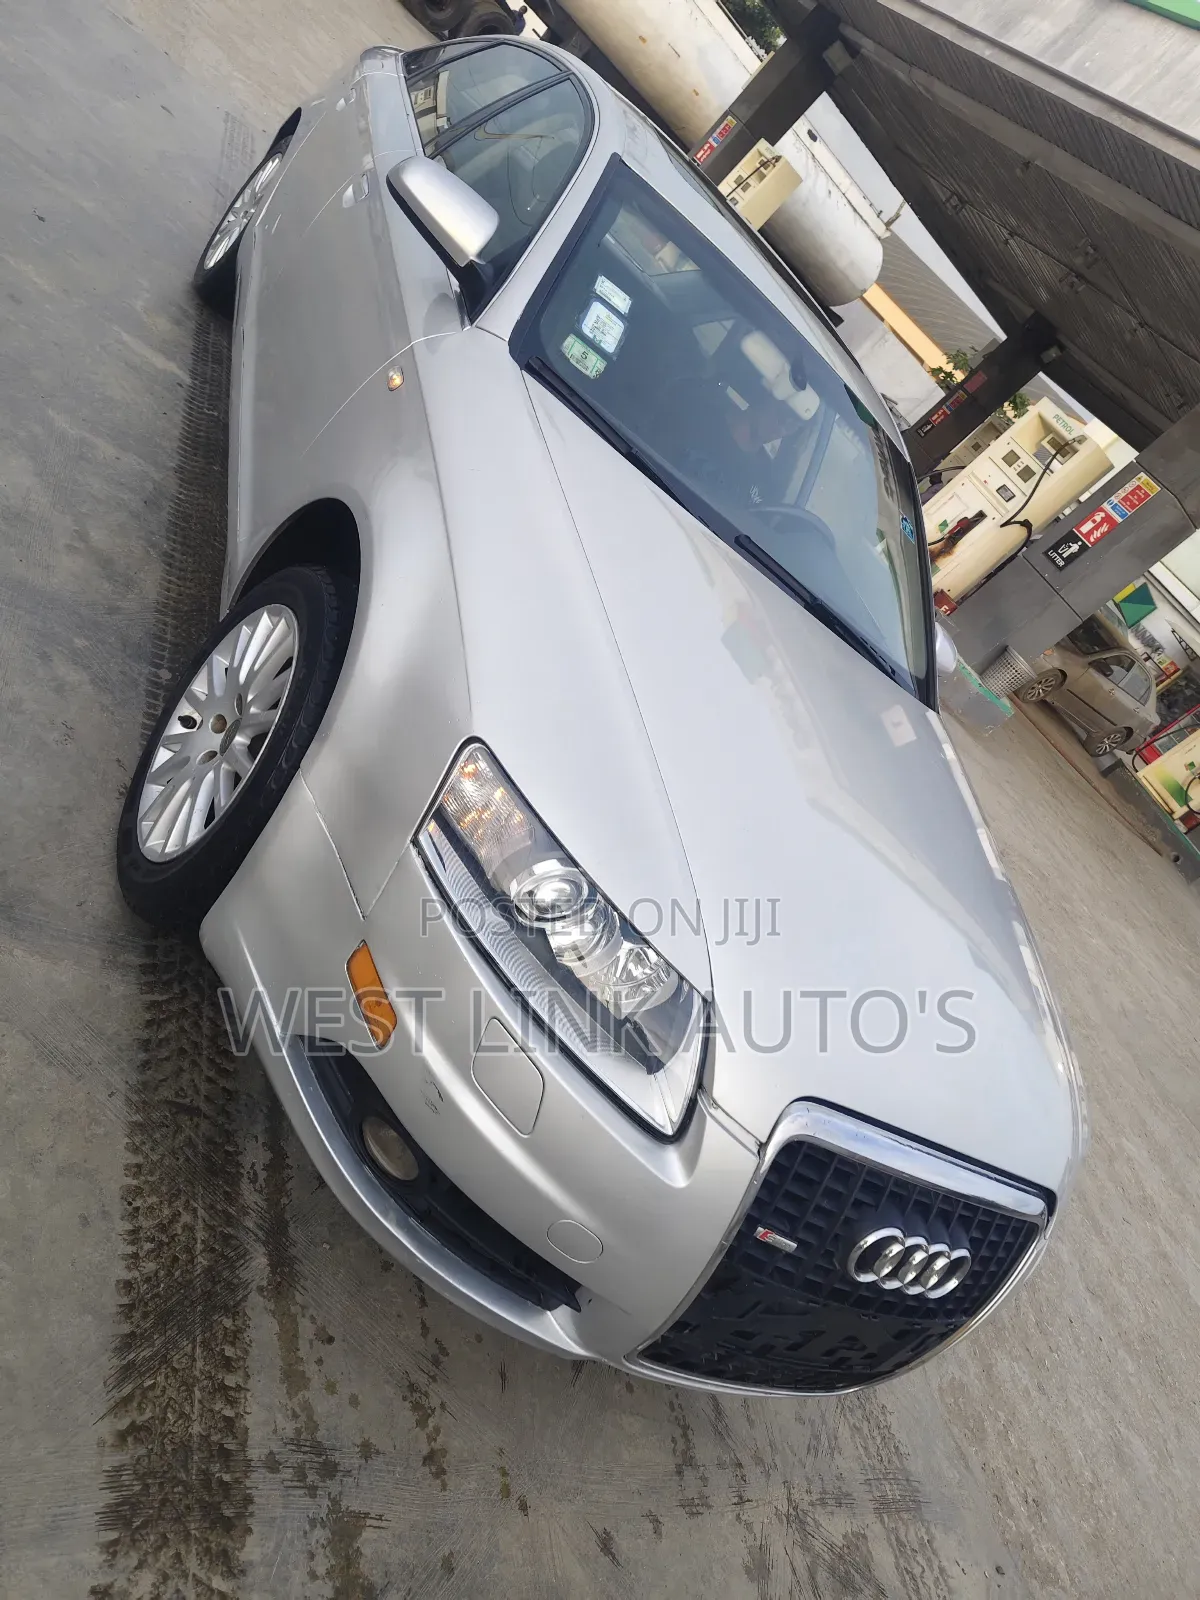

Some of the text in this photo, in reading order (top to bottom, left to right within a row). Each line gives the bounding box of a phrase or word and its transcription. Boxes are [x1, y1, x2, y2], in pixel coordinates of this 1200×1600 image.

[580, 350, 589, 361] 5
[1052, 413, 1075, 436] PETROL
[1047, 549, 1066, 568] LITTER
